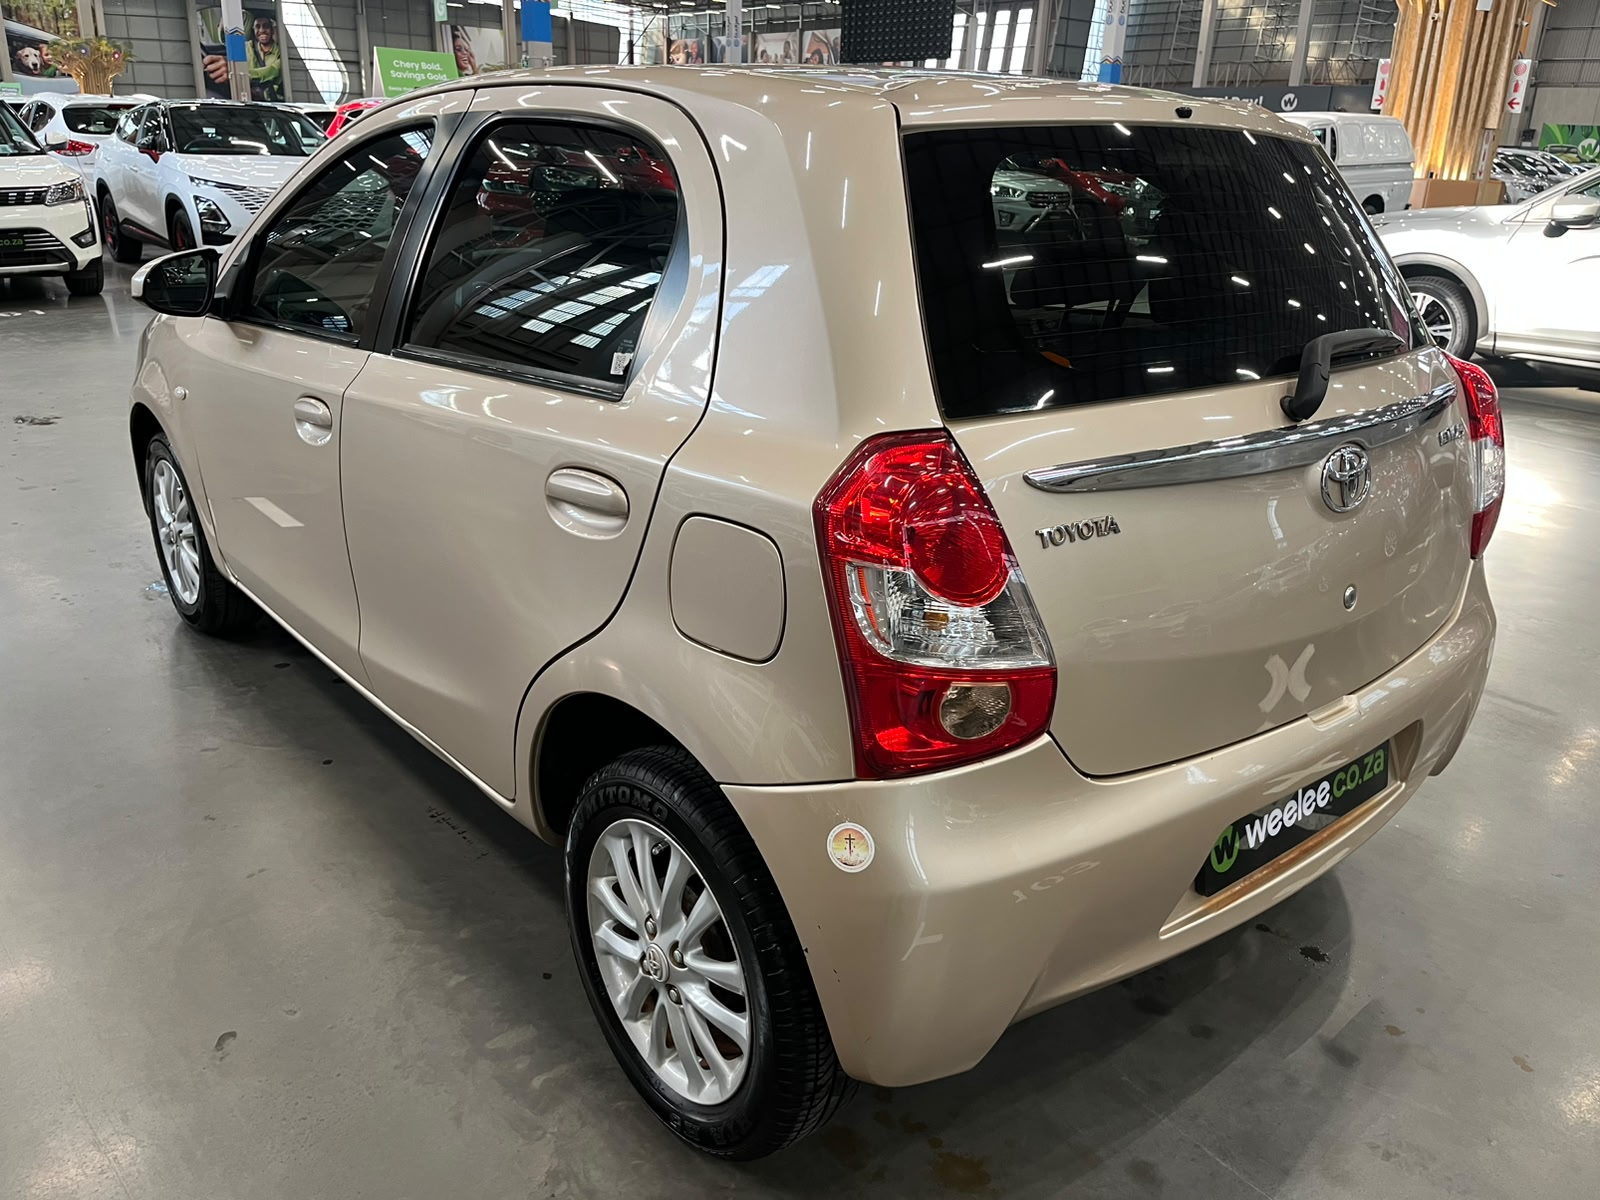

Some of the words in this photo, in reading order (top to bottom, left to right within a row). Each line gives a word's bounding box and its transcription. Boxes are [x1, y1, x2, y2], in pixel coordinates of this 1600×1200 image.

[390, 70, 425, 81] Savings
[393, 60, 420, 70] Chery
[421, 61, 443, 71] Bold.
[1035, 515, 1121, 549] TOYOTA
[1245, 749, 1384, 848] weelee.co.za
